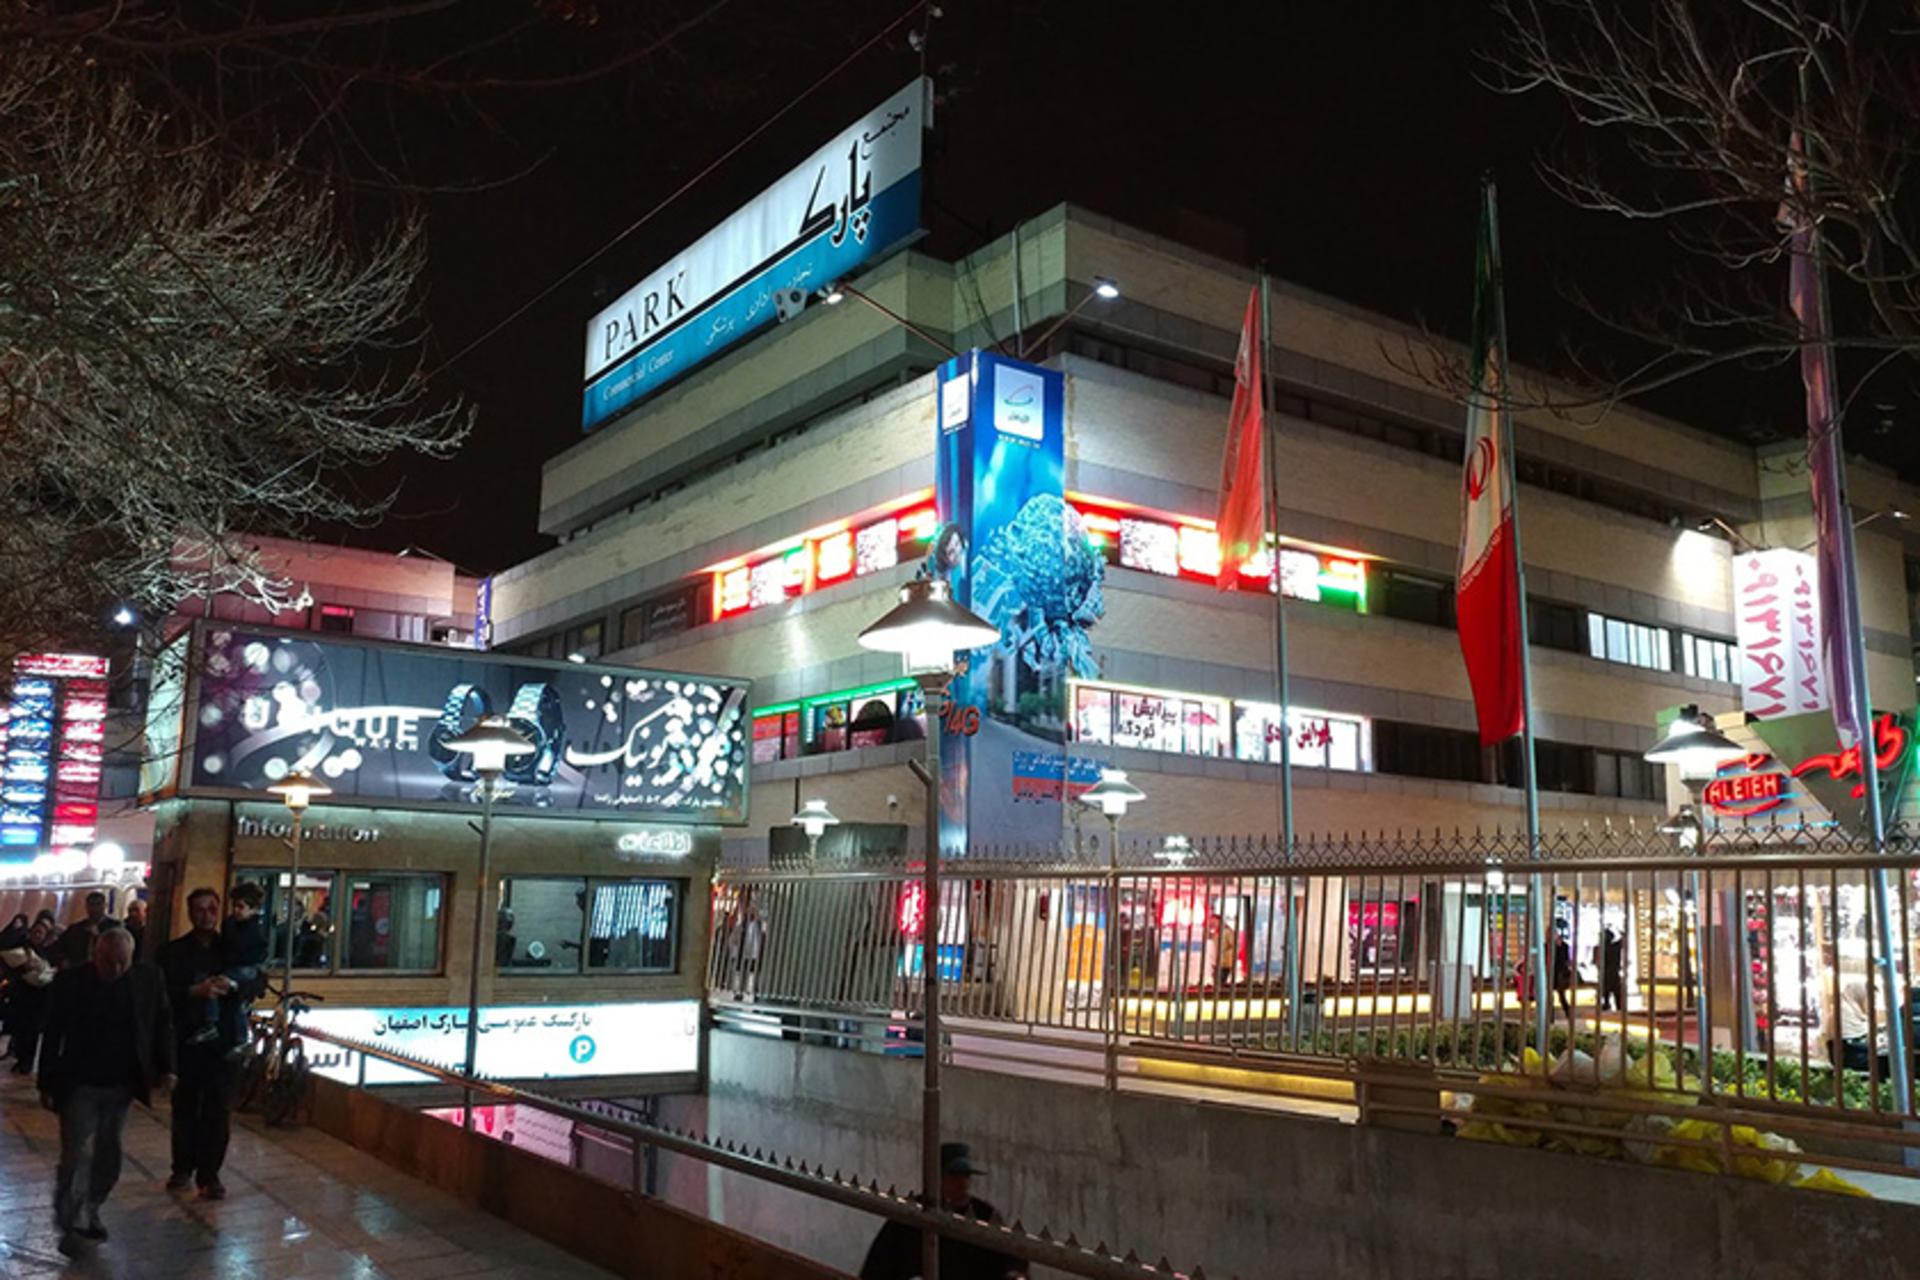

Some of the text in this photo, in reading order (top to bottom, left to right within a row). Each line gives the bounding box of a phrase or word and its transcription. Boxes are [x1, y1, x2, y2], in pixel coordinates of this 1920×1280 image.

[799, 139, 873, 246] پارک
[603, 270, 686, 362] PARK
[373, 1013, 428, 1036] اصفهان
